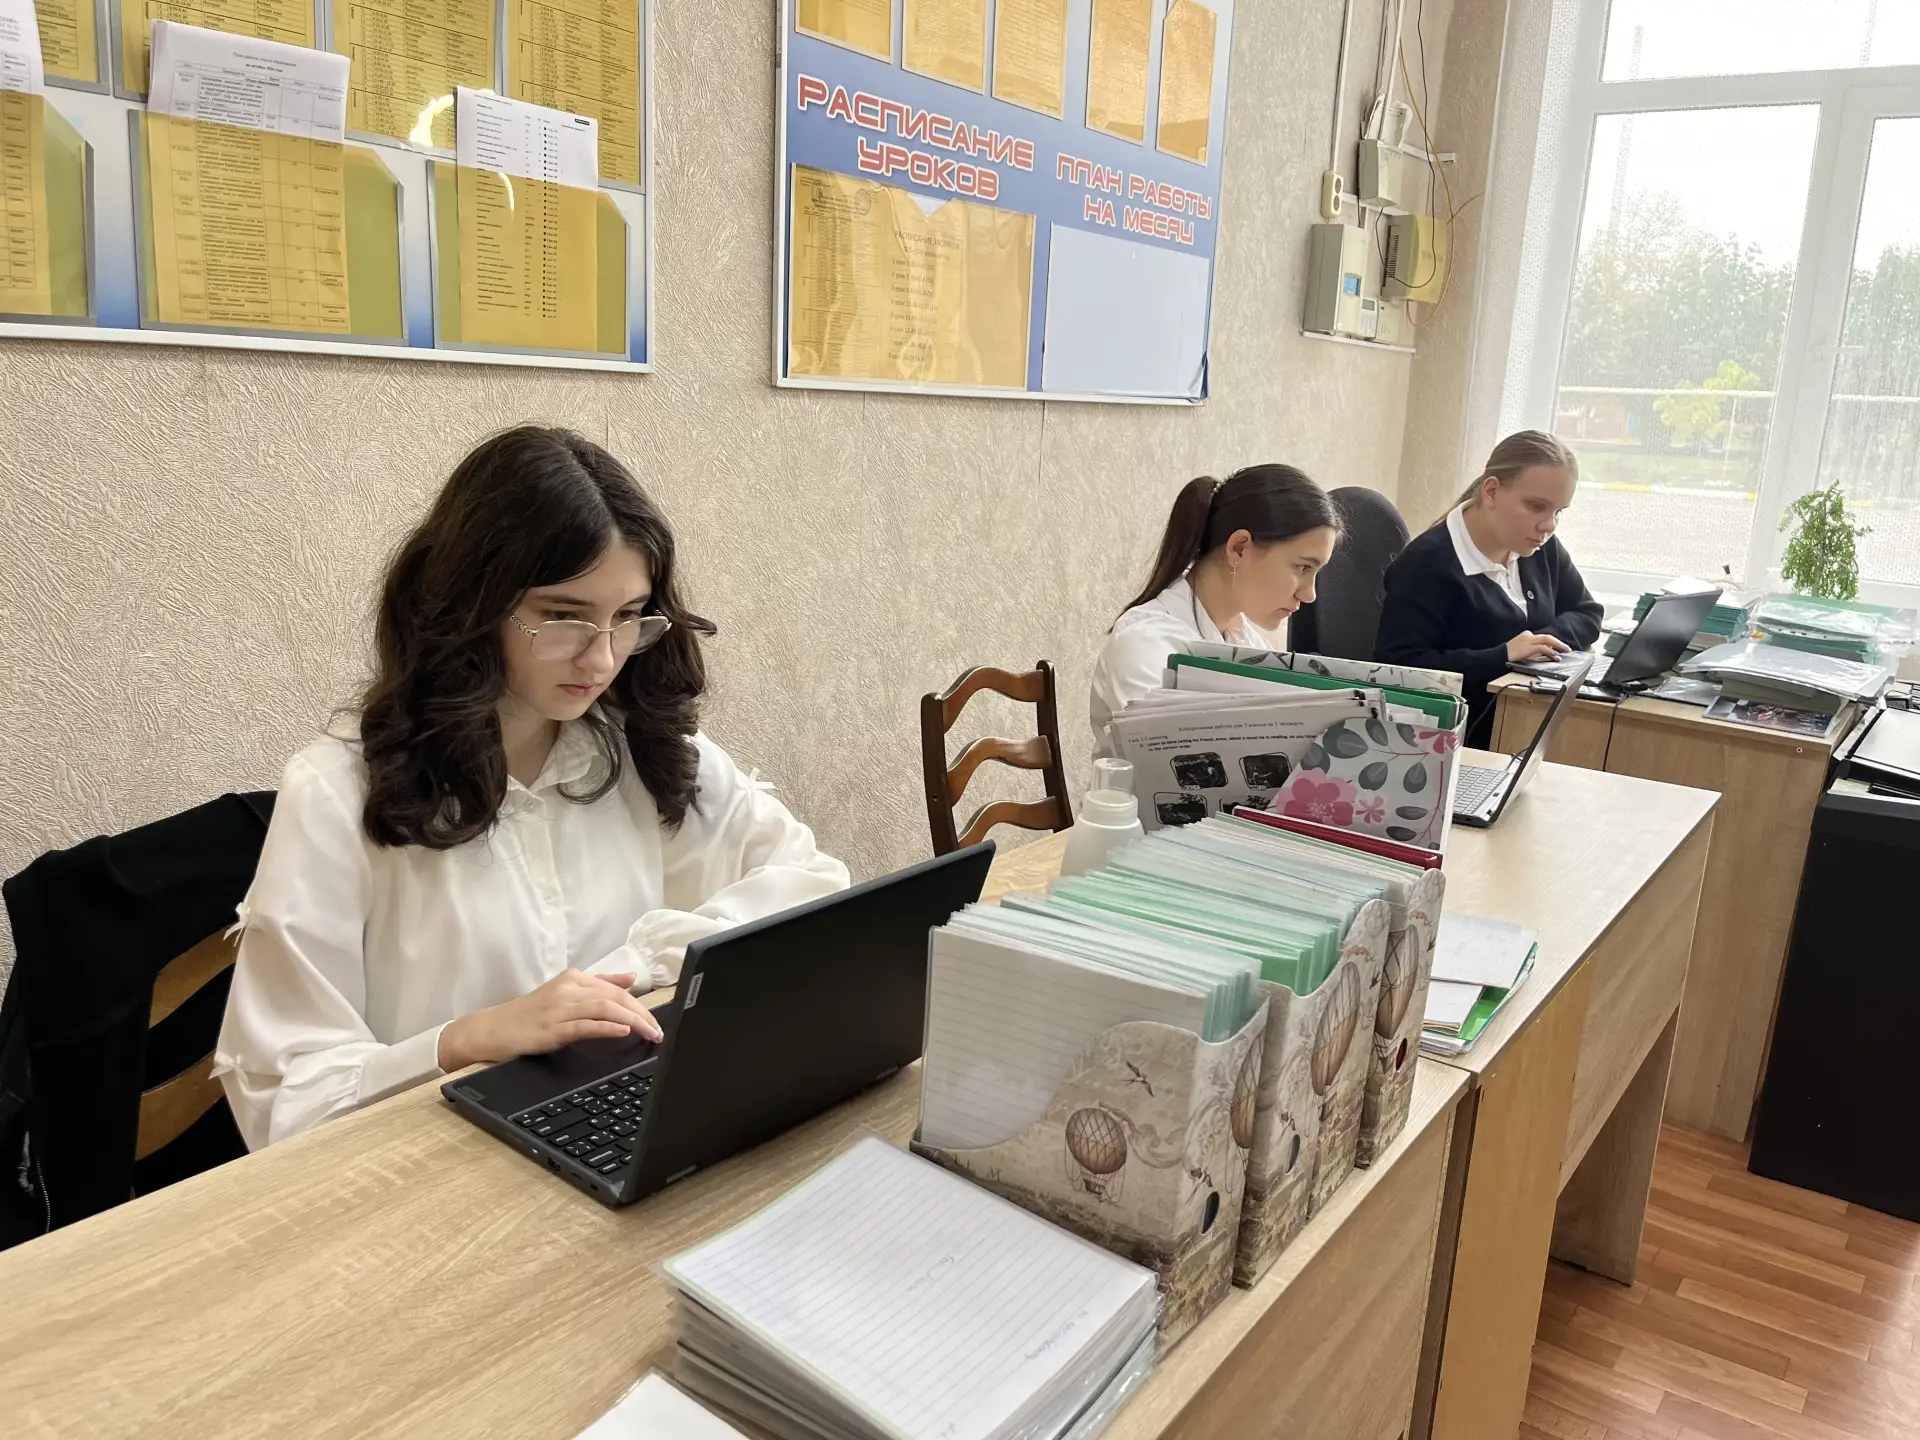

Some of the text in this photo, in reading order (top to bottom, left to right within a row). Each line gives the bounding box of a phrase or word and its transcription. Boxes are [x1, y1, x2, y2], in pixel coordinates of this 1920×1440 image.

[798, 73, 1034, 171] РАСПИСАНИЕ
[858, 137, 999, 200] УРОКОВ
[1056, 152, 1212, 219] ПЛАН РАБОТЫ
[1084, 195, 1195, 246] НА МЕСЯЦ
